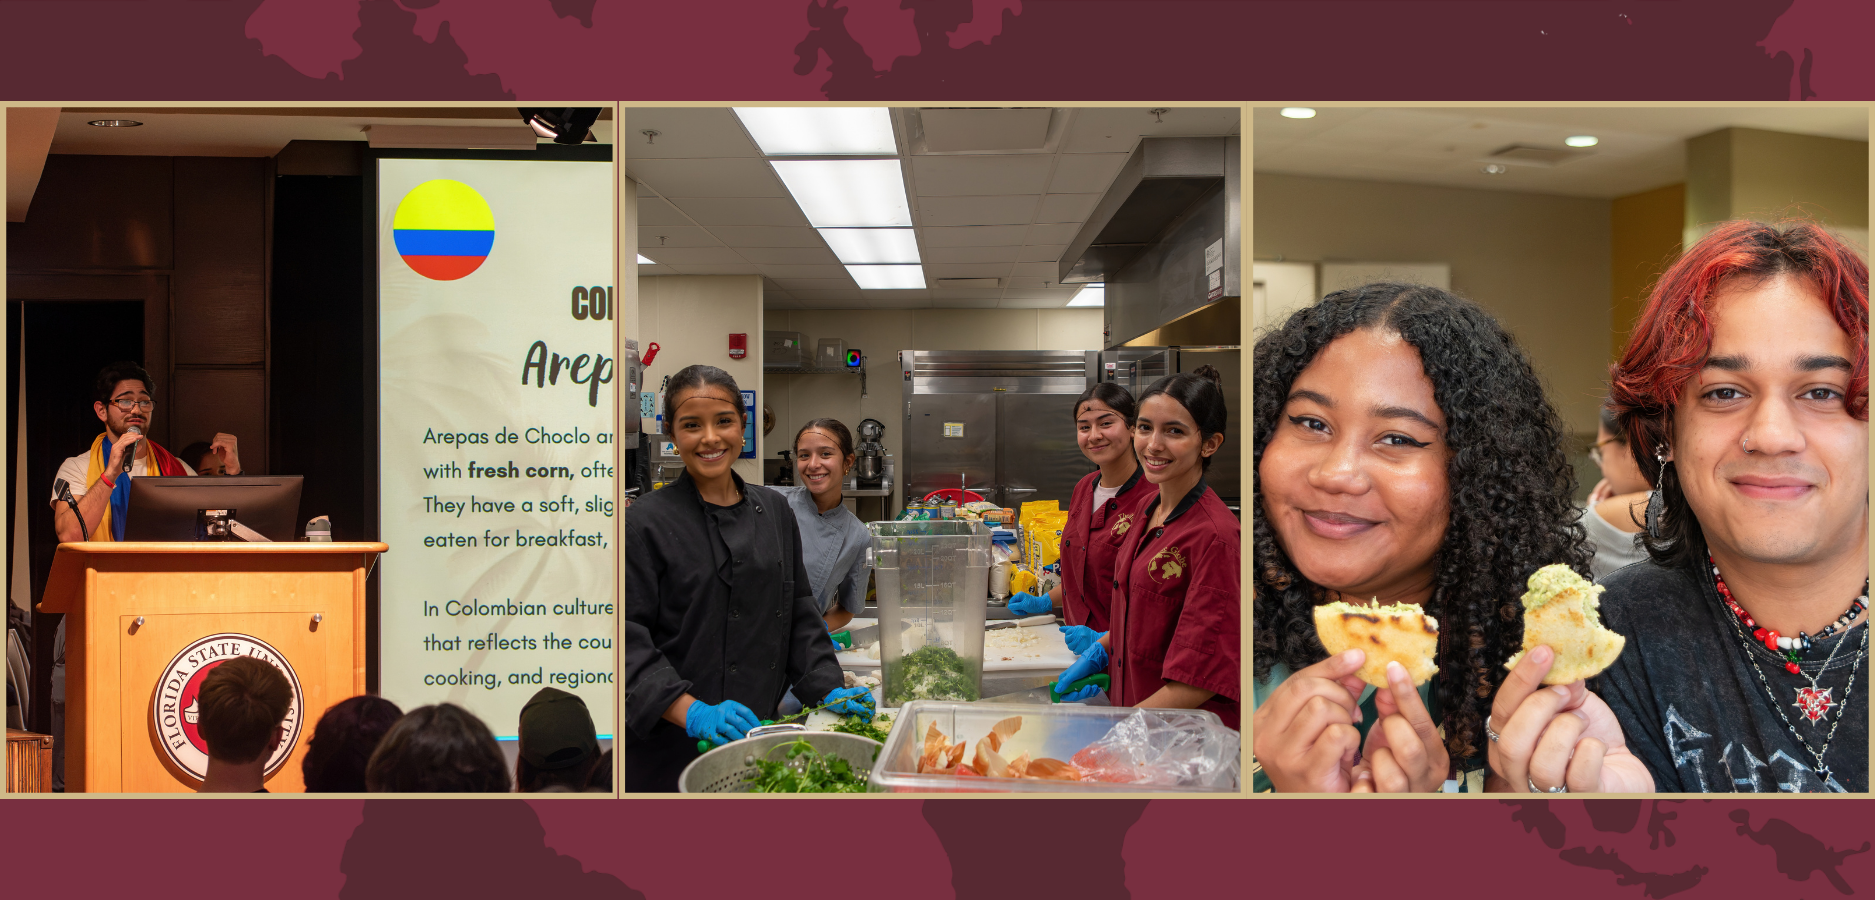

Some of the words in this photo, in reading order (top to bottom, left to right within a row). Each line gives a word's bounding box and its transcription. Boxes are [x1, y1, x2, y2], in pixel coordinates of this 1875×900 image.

[521, 340, 613, 408] Arep
[423, 427, 489, 449] Arepas
[495, 426, 519, 444] de
[525, 426, 590, 444] Choclo
[423, 461, 462, 479] with
[468, 460, 520, 479] fresh
[525, 466, 575, 481] corn,
[423, 495, 466, 518] They
[471, 495, 515, 513] have
[521, 501, 533, 513] a
[539, 494, 579, 515] soft,
[585, 495, 613, 518] slig
[423, 532, 477, 547] eaten
[483, 529, 510, 547] for
[516, 529, 608, 549] breakfast,
[424, 600, 439, 617] In
[445, 598, 546, 617] Colombian
[553, 597, 613, 615] culture
[423, 633, 462, 651] that
[468, 633, 537, 650] reflects
[543, 632, 572, 650] the
[578, 638, 612, 650] cou
[424, 667, 502, 690] cooking,
[508, 667, 543, 684] and
[163, 669, 189, 751] FLORIDA
[188, 642, 241, 668] STATE
